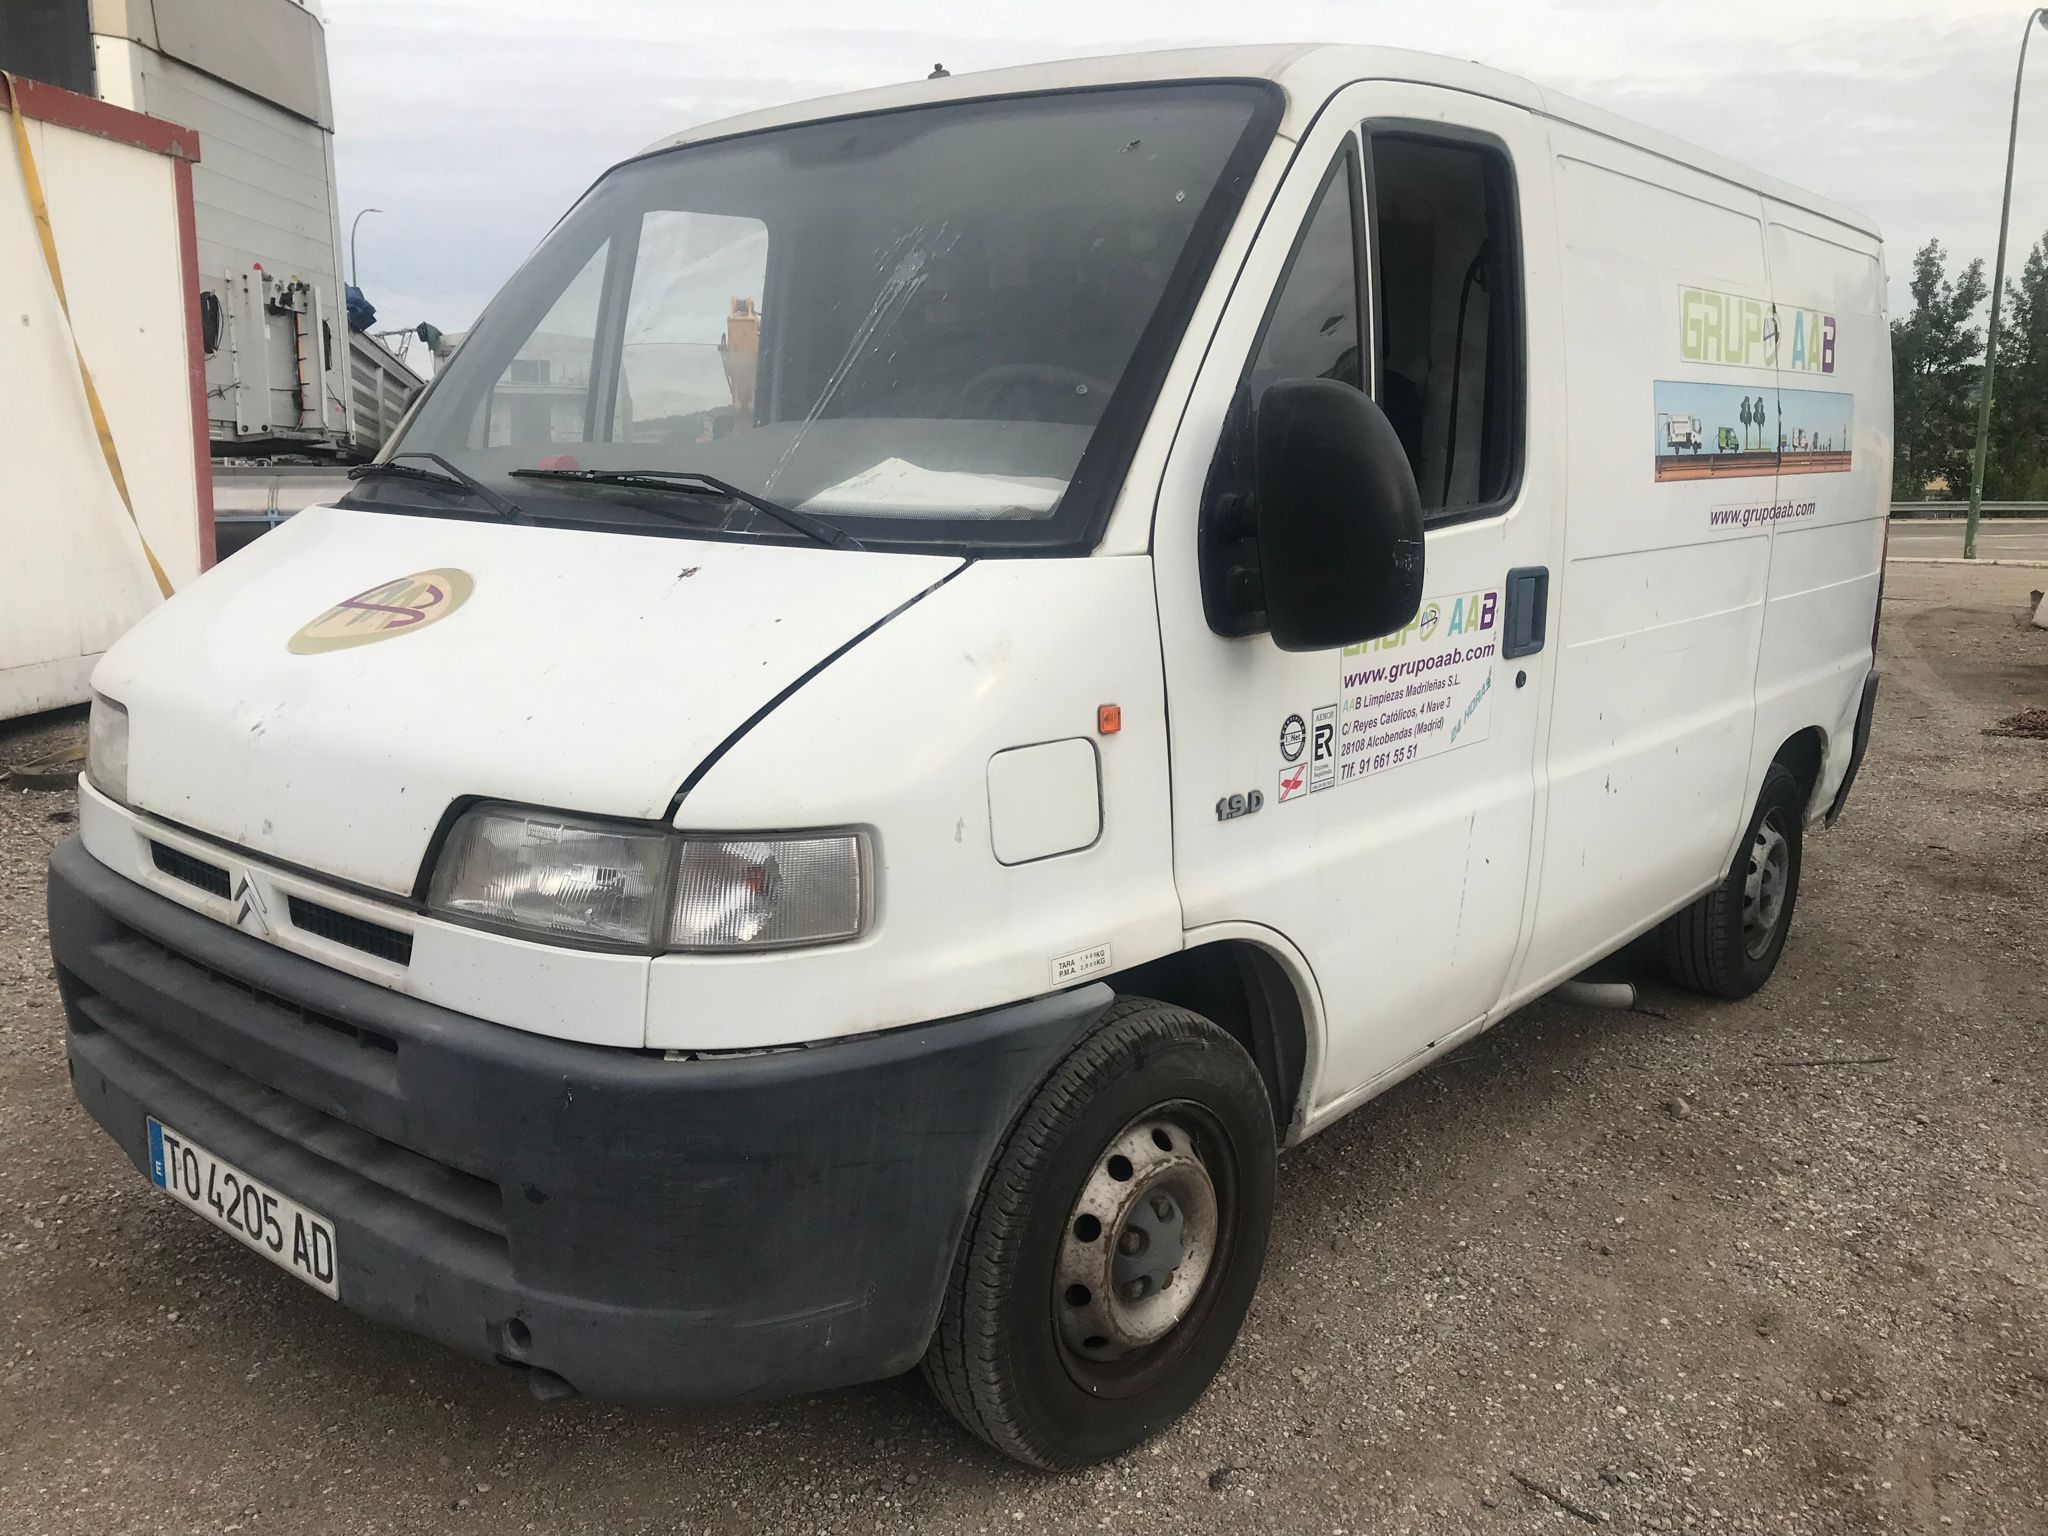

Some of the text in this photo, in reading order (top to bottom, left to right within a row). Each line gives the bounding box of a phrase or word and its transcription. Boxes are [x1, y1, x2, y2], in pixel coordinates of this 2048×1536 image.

[1683, 290, 1836, 373] GRUPO AAB
[1710, 501, 1816, 527] www.grupoaab.com
[1447, 592, 1498, 637] AAB
[1344, 643, 1495, 689] www.grupoaab.com
[1363, 688, 1404, 709] Limpiezas
[1406, 678, 1446, 698] Madrileñas
[1447, 674, 1461, 688] S.L.
[1315, 711, 1335, 722] AENOR
[1341, 696, 1452, 737] C/ Reyes Católicos, 4 Nave 3
[1341, 716, 1445, 757] 28108 Alcobendas (Madrid)
[1341, 762, 1356, 781] Tlf.
[1359, 756, 1371, 775] 91
[1373, 751, 1391, 771] 661
[1393, 747, 1405, 764] 55
[1406, 743, 1418, 760] 51
[1058, 959, 1075, 970] TARA
[155, 1160, 163, 1176] E
[164, 1134, 334, 1284] TO 4205 AD
